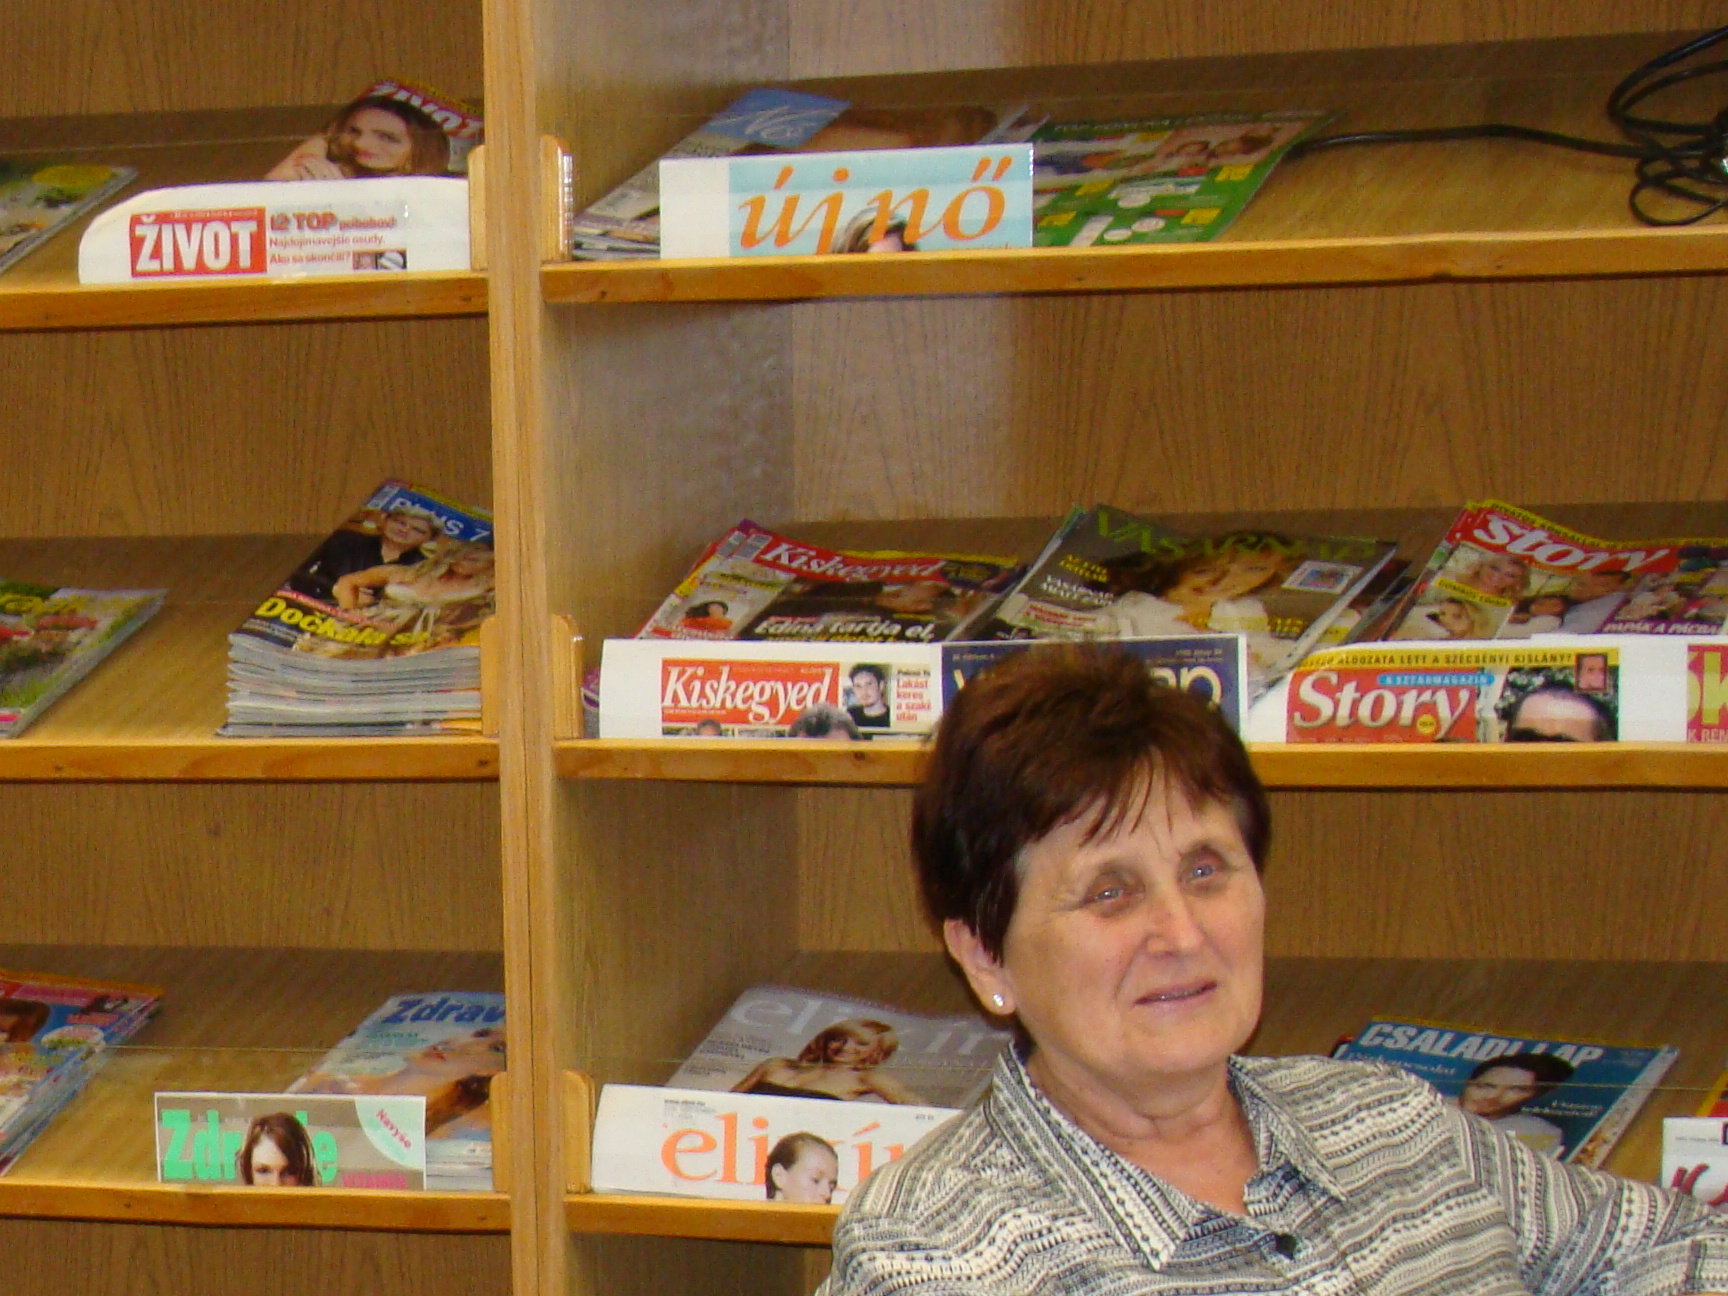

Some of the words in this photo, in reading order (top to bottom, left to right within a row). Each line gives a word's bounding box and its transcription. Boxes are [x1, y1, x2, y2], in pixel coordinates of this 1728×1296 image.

[292, 211, 338, 230] TOP
[739, 156, 1012, 256] újnő
[134, 213, 259, 272] ŽIVOT
[761, 541, 948, 582] Kiskegyed
[1431, 653, 1441, 664] A
[662, 664, 834, 724] Kiskegyed
[1293, 671, 1471, 741] Story
[161, 1109, 339, 1183] Zdre
